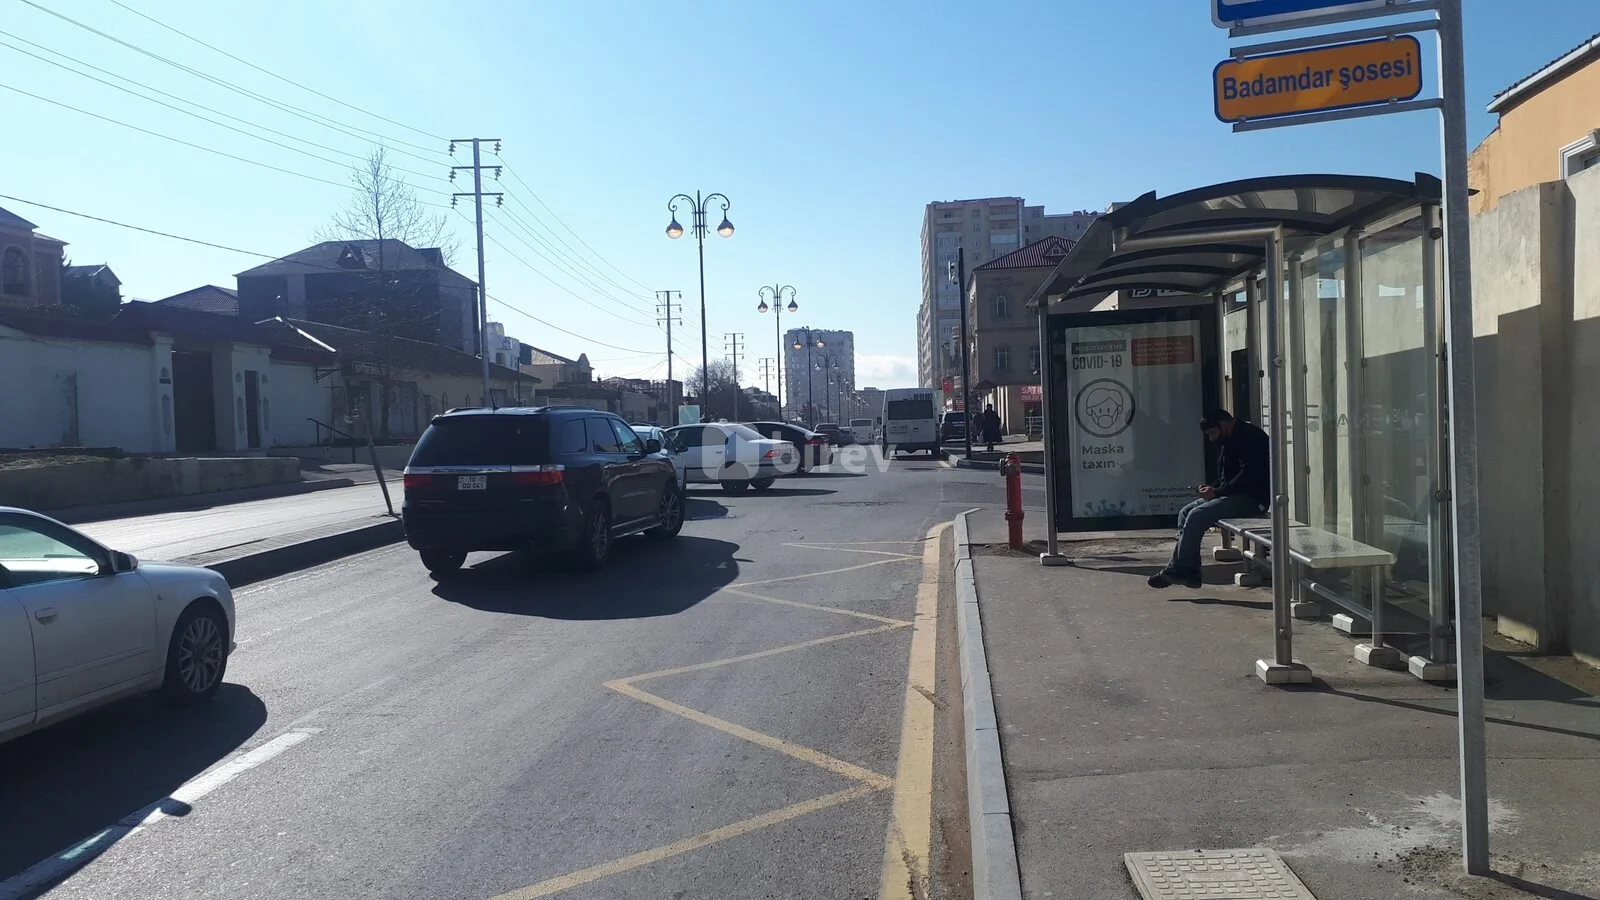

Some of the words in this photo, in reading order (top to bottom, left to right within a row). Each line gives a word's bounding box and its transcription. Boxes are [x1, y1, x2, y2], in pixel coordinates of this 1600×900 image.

[1223, 66, 1335, 100] Badamdar
[1339, 52, 1412, 91] şosesi
[1072, 354, 1122, 370] COVID-19
[1082, 444, 1124, 455] Maska
